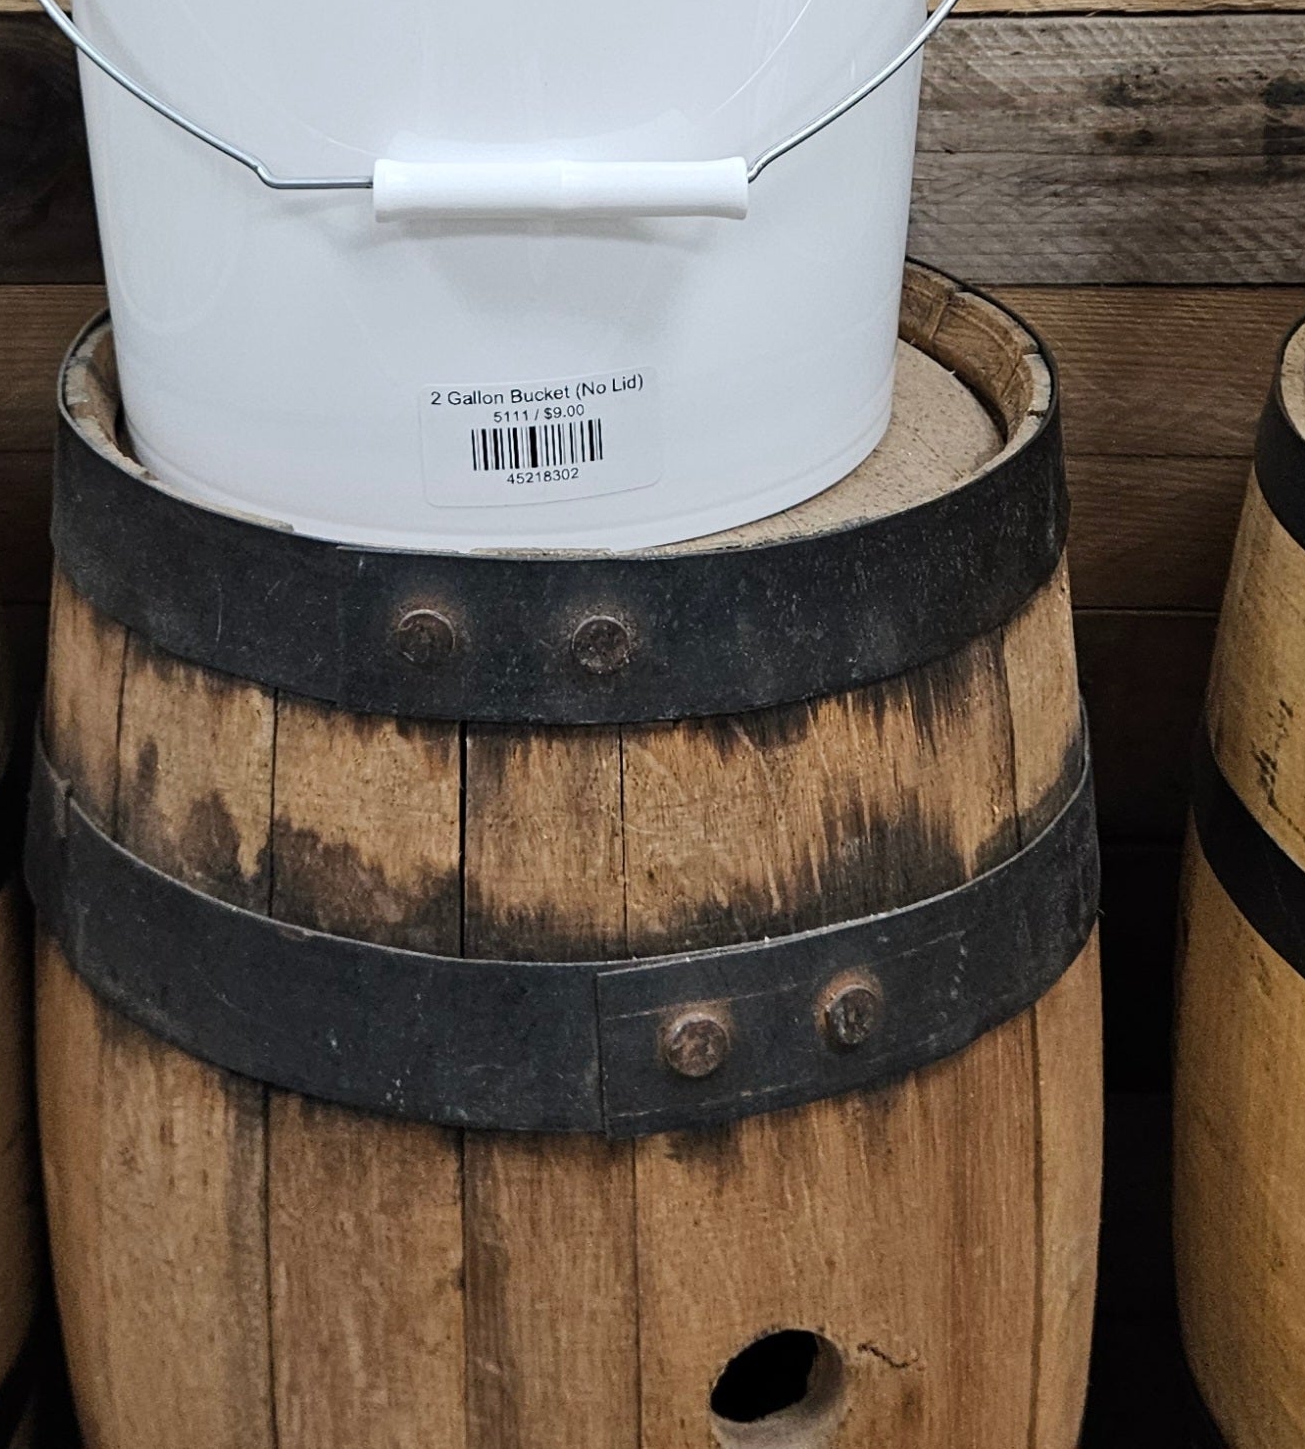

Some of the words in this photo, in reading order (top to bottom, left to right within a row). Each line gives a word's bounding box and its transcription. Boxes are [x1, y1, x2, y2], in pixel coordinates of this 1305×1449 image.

[430, 391, 442, 406] 2
[447, 389, 505, 406] Gallon
[510, 385, 570, 403] Bucket
[575, 381, 607, 401] (No
[611, 373, 644, 392] Lid)
[493, 410, 530, 423] 5111
[533, 408, 540, 422] /
[543, 403, 585, 420] $9.00
[506, 467, 579, 485] 45218302
